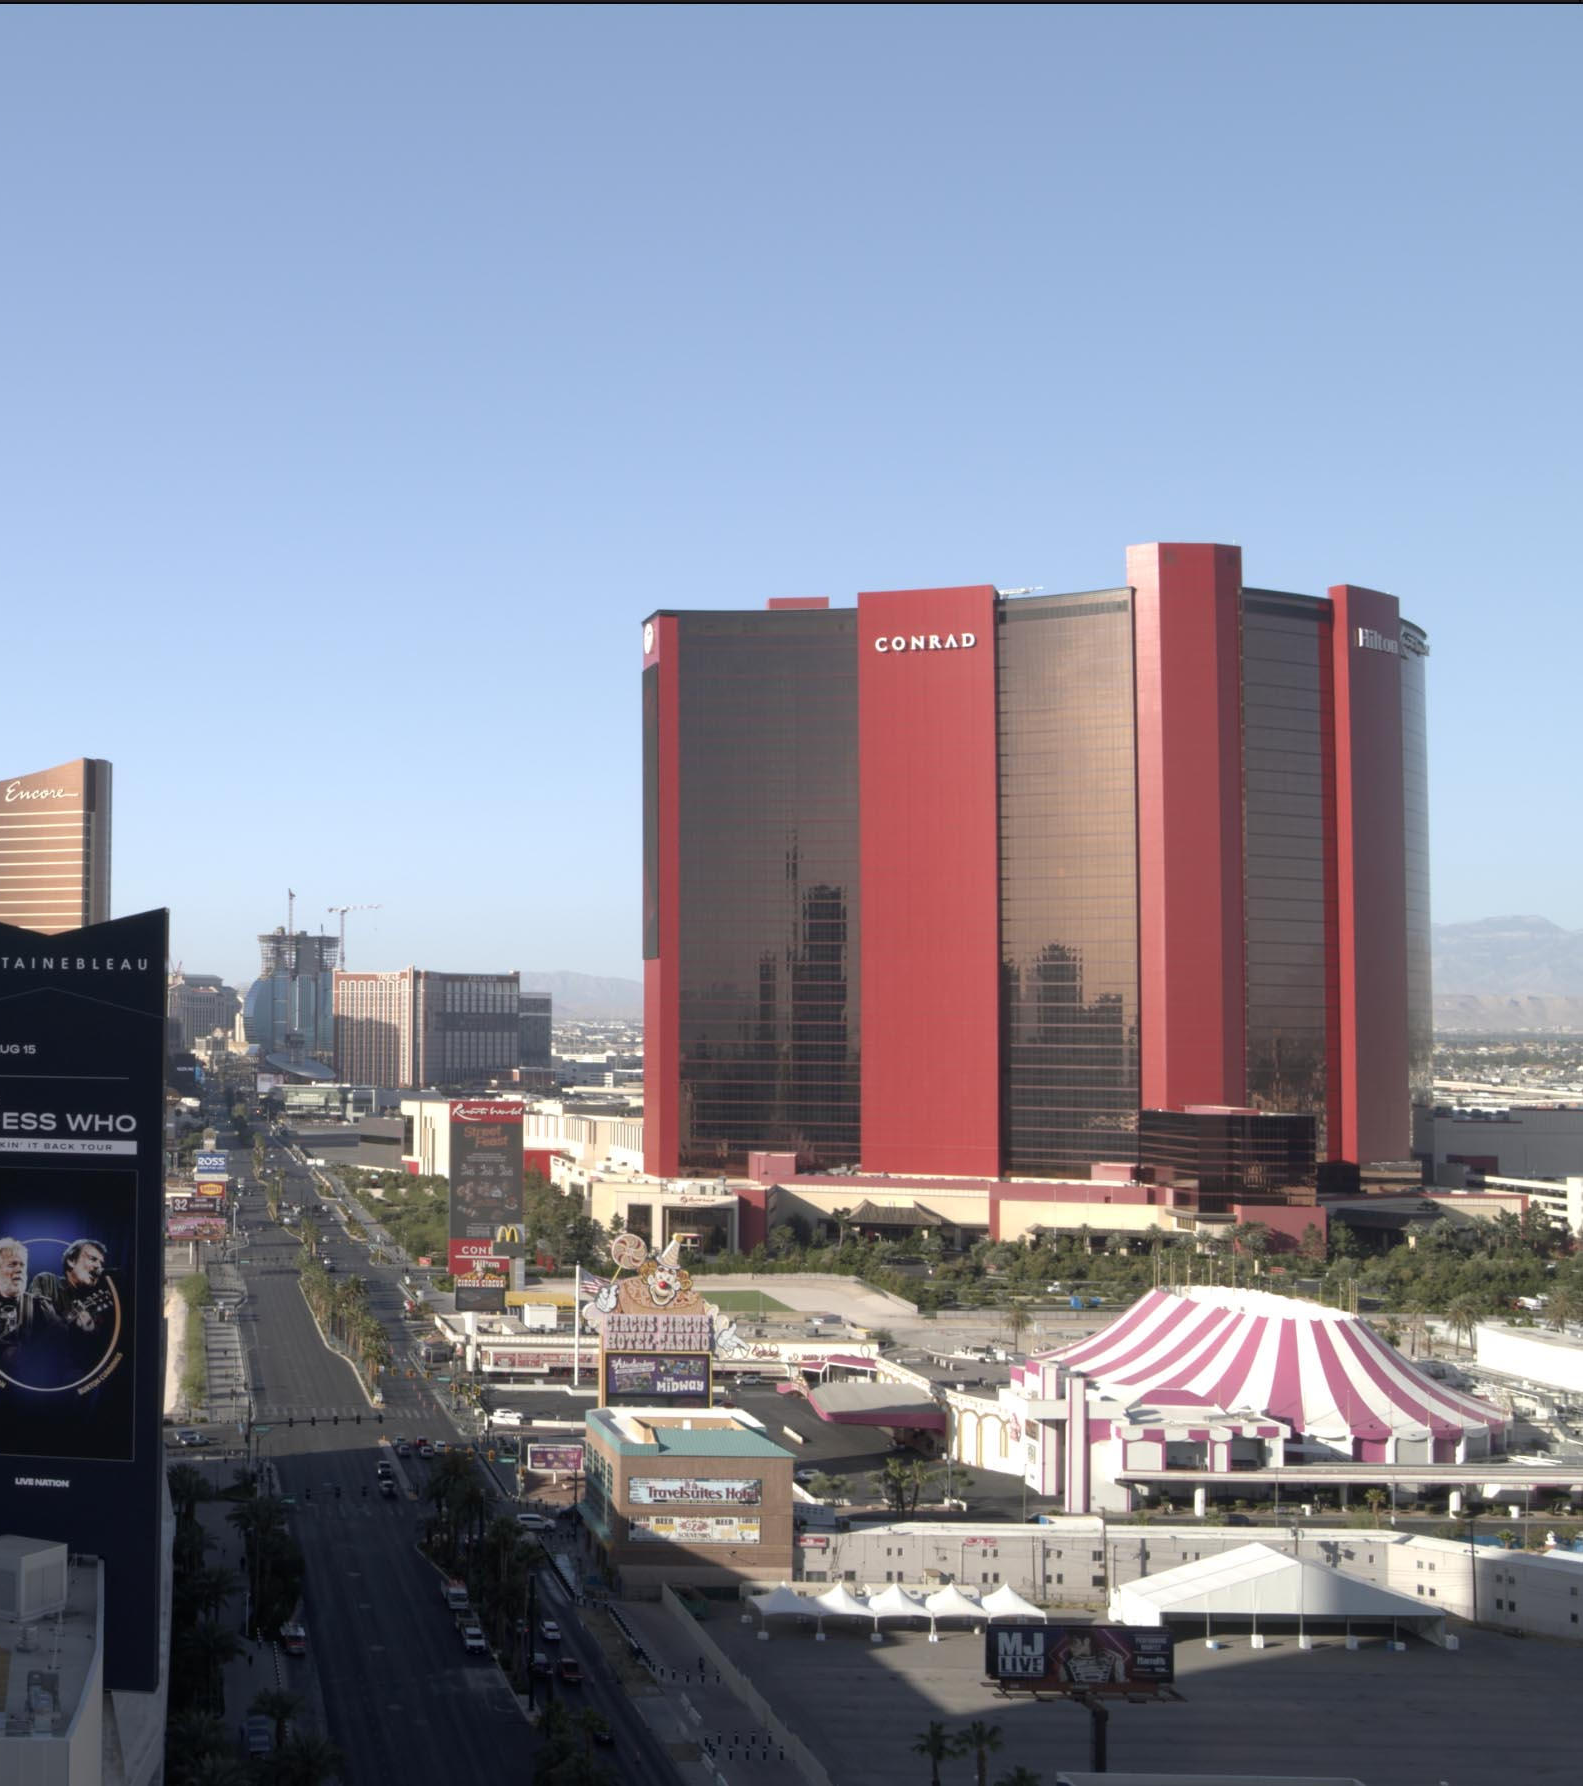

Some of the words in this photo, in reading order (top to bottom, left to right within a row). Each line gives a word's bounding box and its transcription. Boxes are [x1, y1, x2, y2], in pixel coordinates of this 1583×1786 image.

[874, 632, 976, 652] CONRAD
[1358, 627, 1399, 654] Hilton
[5, 780, 78, 802] Encore
[23, 1044, 36, 1054] 15
[66, 1113, 137, 1133] WHO
[44, 1142, 75, 1150] BACK
[81, 1143, 112, 1151] TOUR
[197, 1157, 225, 1166] ROSS
[174, 1199, 188, 1210] 32
[457, 1279, 479, 1287] CIRCUS
[481, 1279, 504, 1287] CIRCUS
[607, 1315, 657, 1333] CIRCUS
[659, 1316, 709, 1334] CIRCUS
[15, 1477, 34, 1486] LIVE
[35, 1478, 69, 1487] NATION
[647, 1486, 723, 1500] Travelsuites
[998, 1632, 1044, 1656] MJ
[999, 1657, 1043, 1673] LIVE
